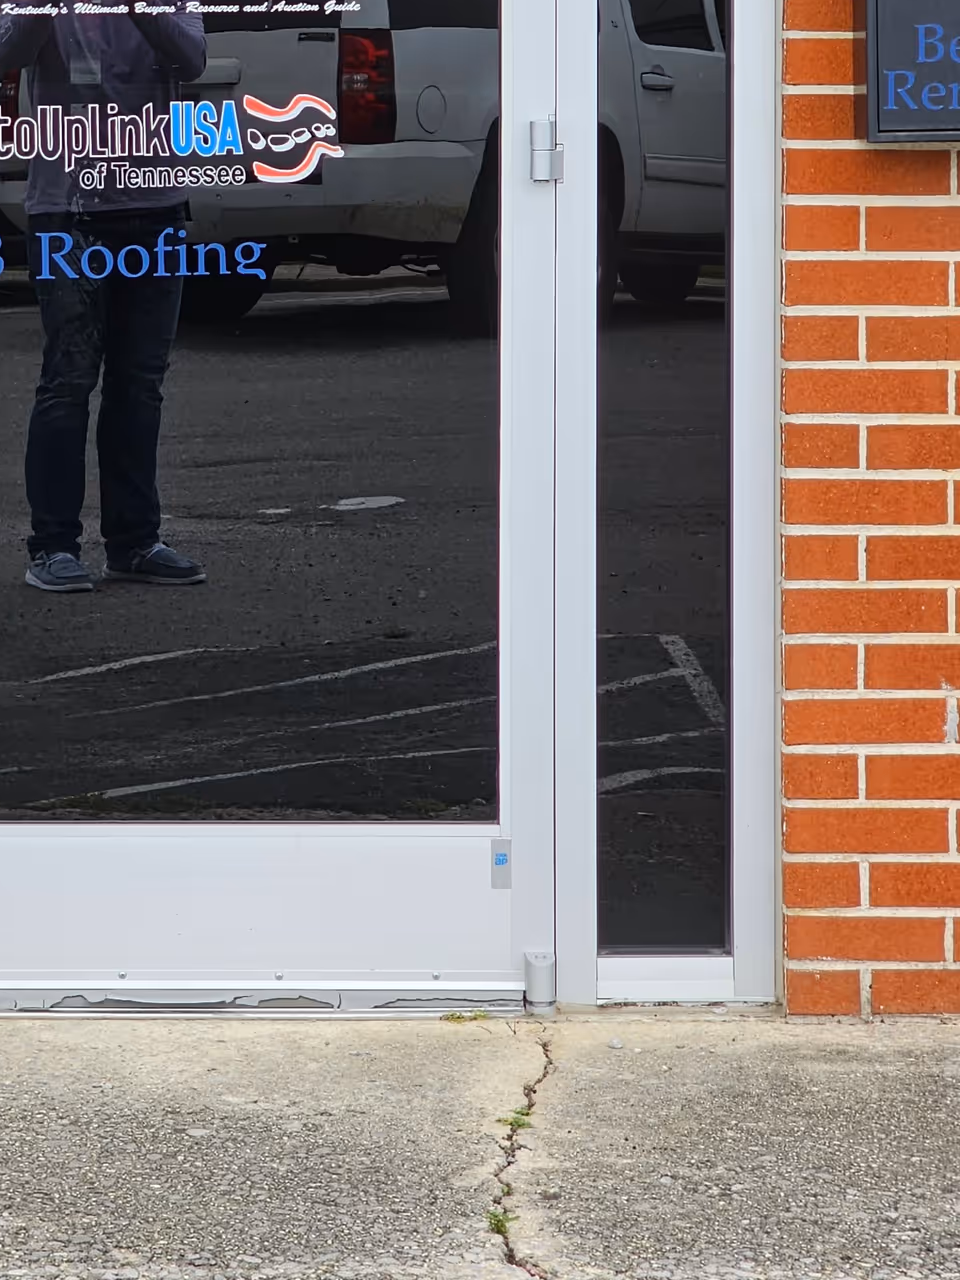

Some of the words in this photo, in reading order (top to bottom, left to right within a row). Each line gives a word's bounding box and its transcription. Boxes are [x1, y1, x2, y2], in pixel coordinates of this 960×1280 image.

[0, 2, 68, 18] Kentucky's
[73, 3, 130, 15] Ultimate
[186, 0, 240, 14] Resource
[242, 0, 268, 13] and
[270, 0, 320, 13] Auction
[323, 0, 362, 16] Guide
[79, 163, 107, 190] of
[110, 161, 247, 190] Tennessee
[35, 226, 268, 281] Roofing
